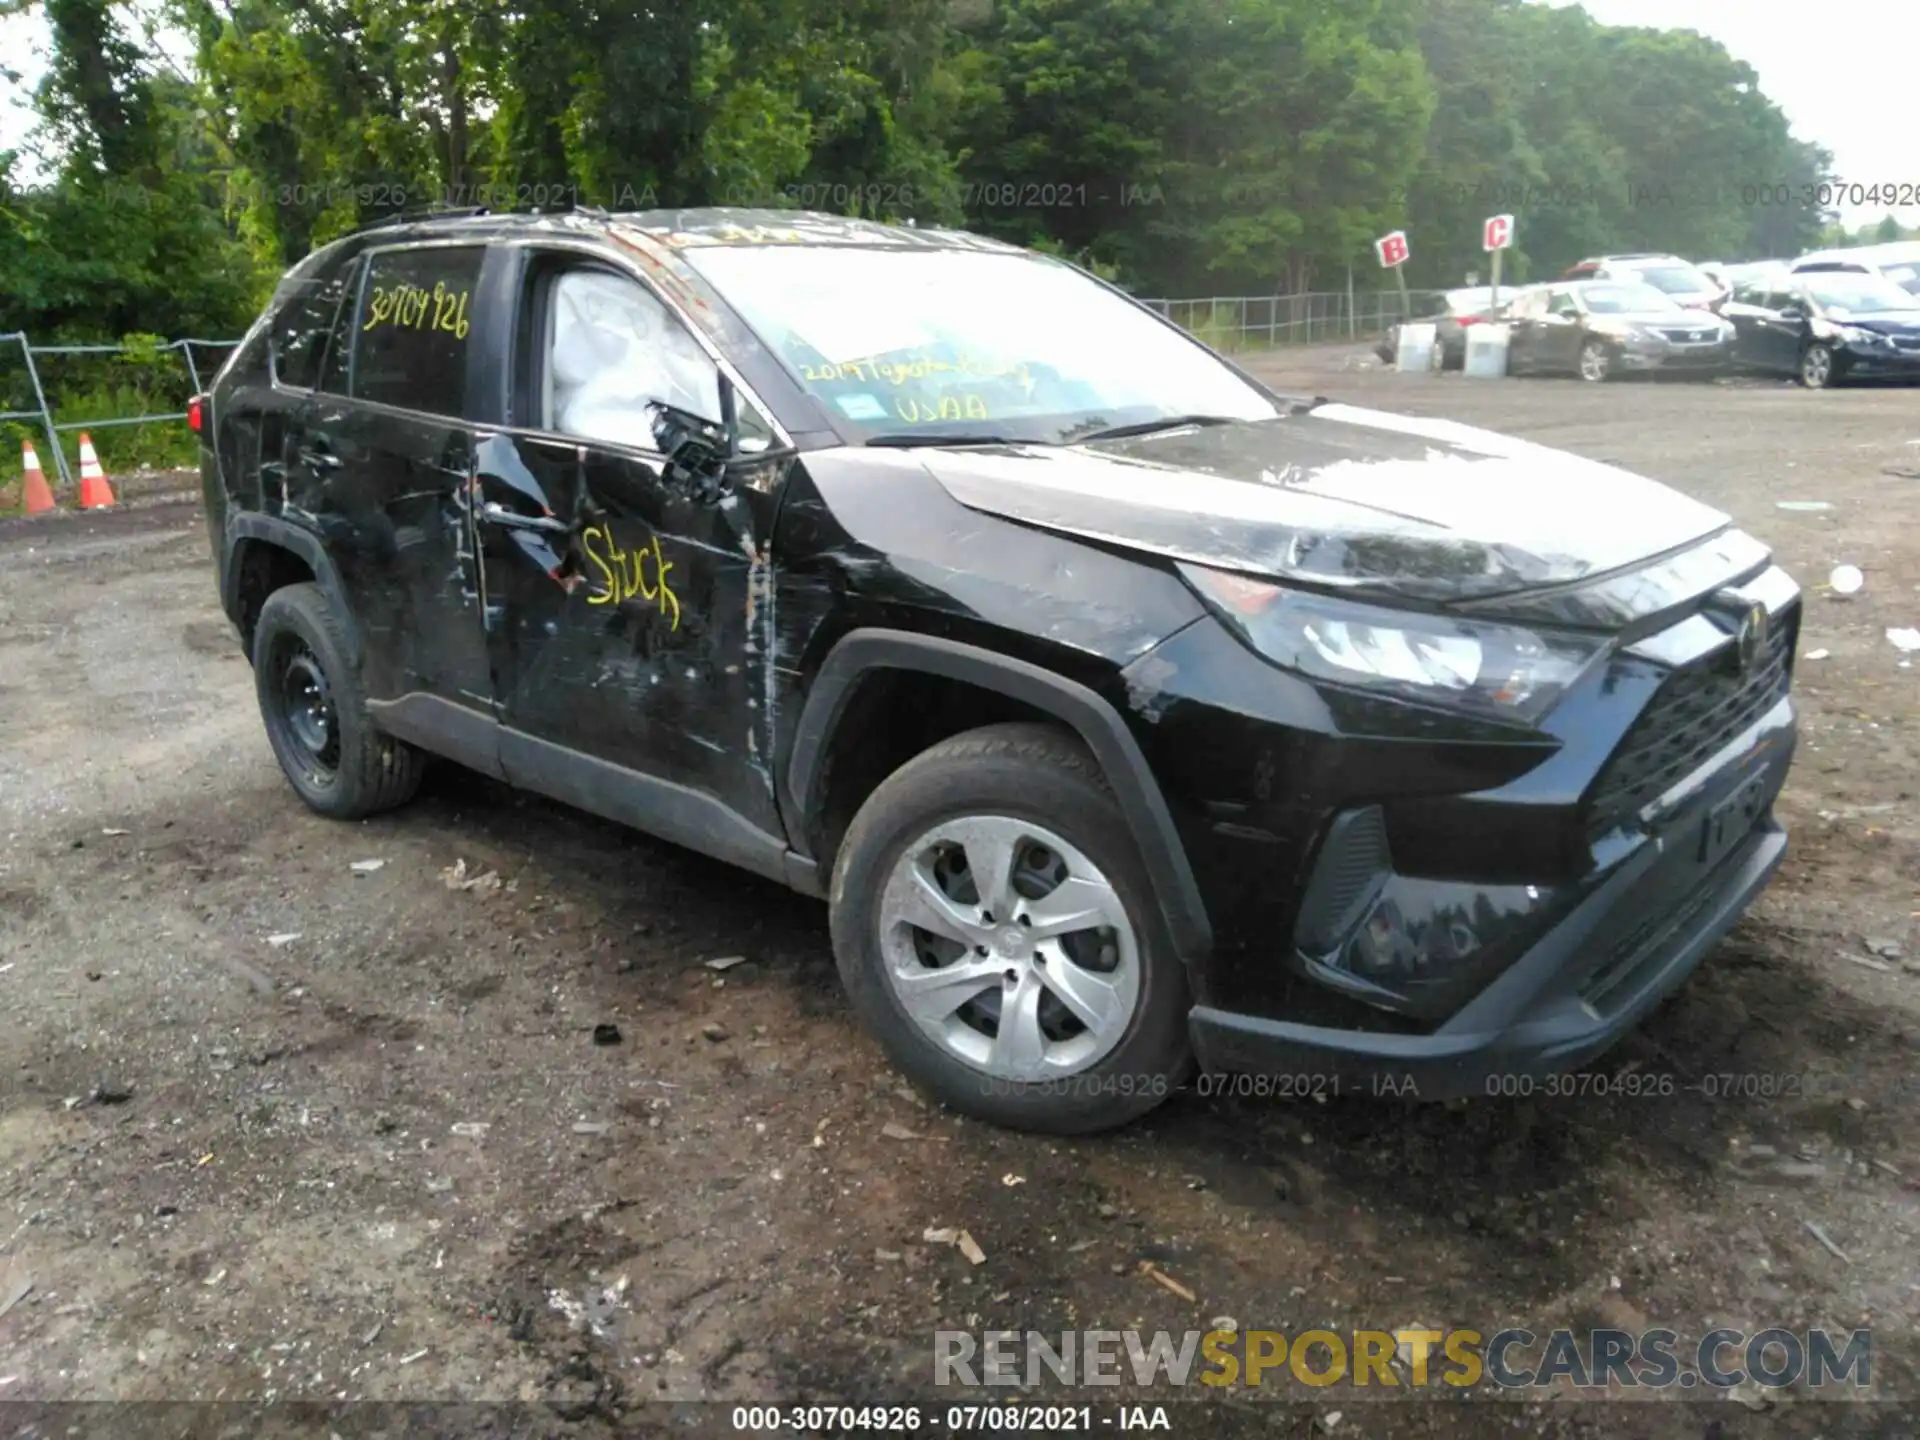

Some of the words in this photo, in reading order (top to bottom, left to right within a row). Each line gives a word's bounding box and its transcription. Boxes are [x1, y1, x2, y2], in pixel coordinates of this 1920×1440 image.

[1487, 218, 1506, 247] C
[1382, 236, 1408, 264] B
[583, 521, 680, 632] Stuck
